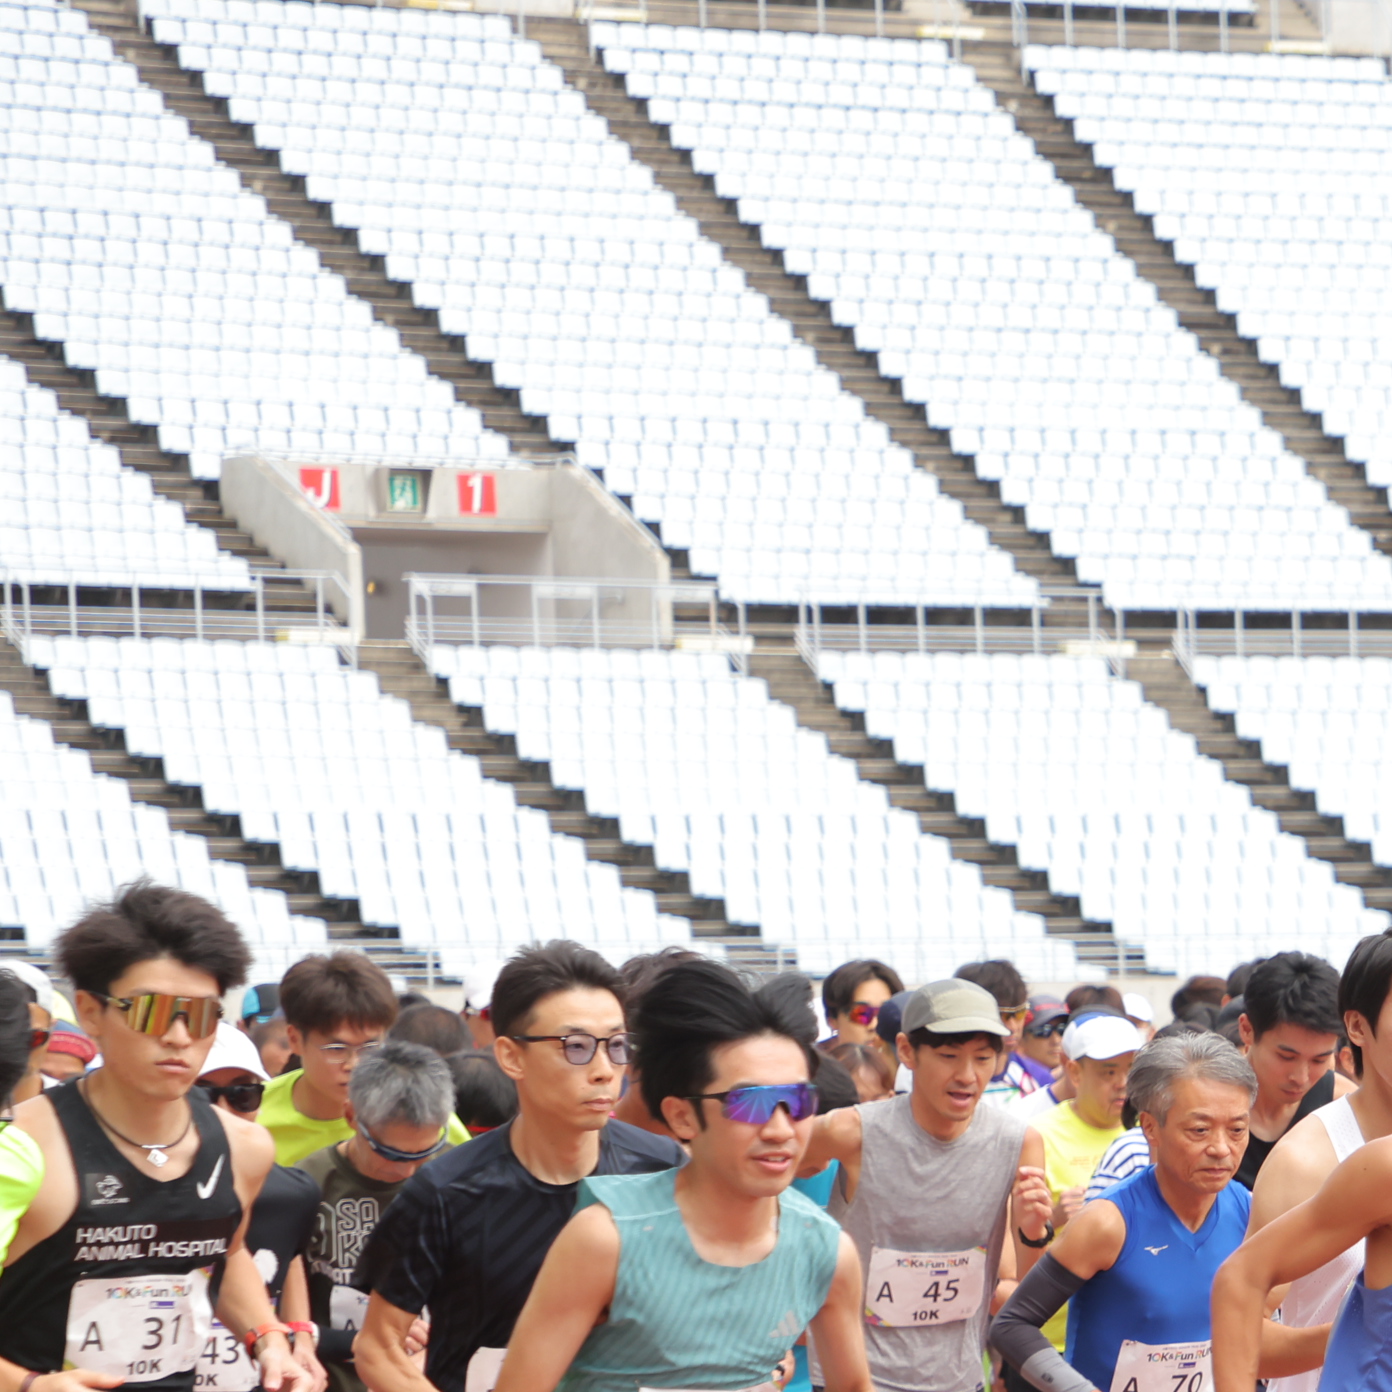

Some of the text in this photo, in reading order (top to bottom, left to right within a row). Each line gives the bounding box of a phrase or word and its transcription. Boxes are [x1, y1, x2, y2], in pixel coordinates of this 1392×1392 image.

[467, 472, 482, 513] 1
[75, 1224, 157, 1243] HAKUTO
[74, 1238, 228, 1261] ANIMAL HOSPITAL
[875, 1279, 960, 1303] A 45
[912, 1309, 939, 1321] 10K
[79, 1314, 182, 1352] A 31
[200, 1335, 241, 1366] 43
[126, 1359, 162, 1376] 10K
